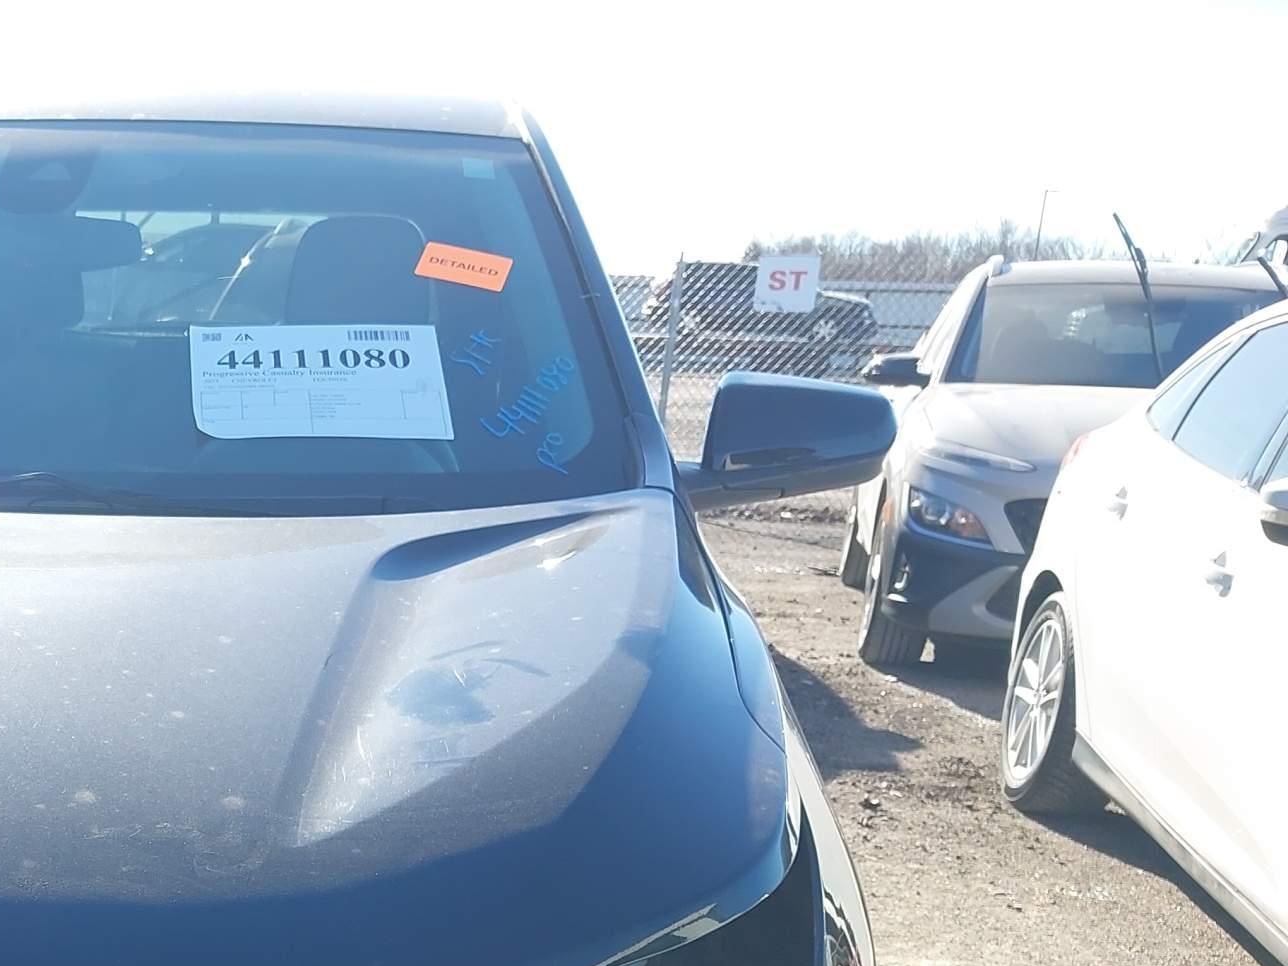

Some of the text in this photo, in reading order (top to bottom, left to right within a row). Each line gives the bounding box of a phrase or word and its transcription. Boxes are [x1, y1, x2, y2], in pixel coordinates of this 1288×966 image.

[429, 256, 499, 277] DETAILED
[768, 270, 808, 291] ST
[216, 348, 411, 370] 44111080
[202, 370, 259, 378] Progressive
